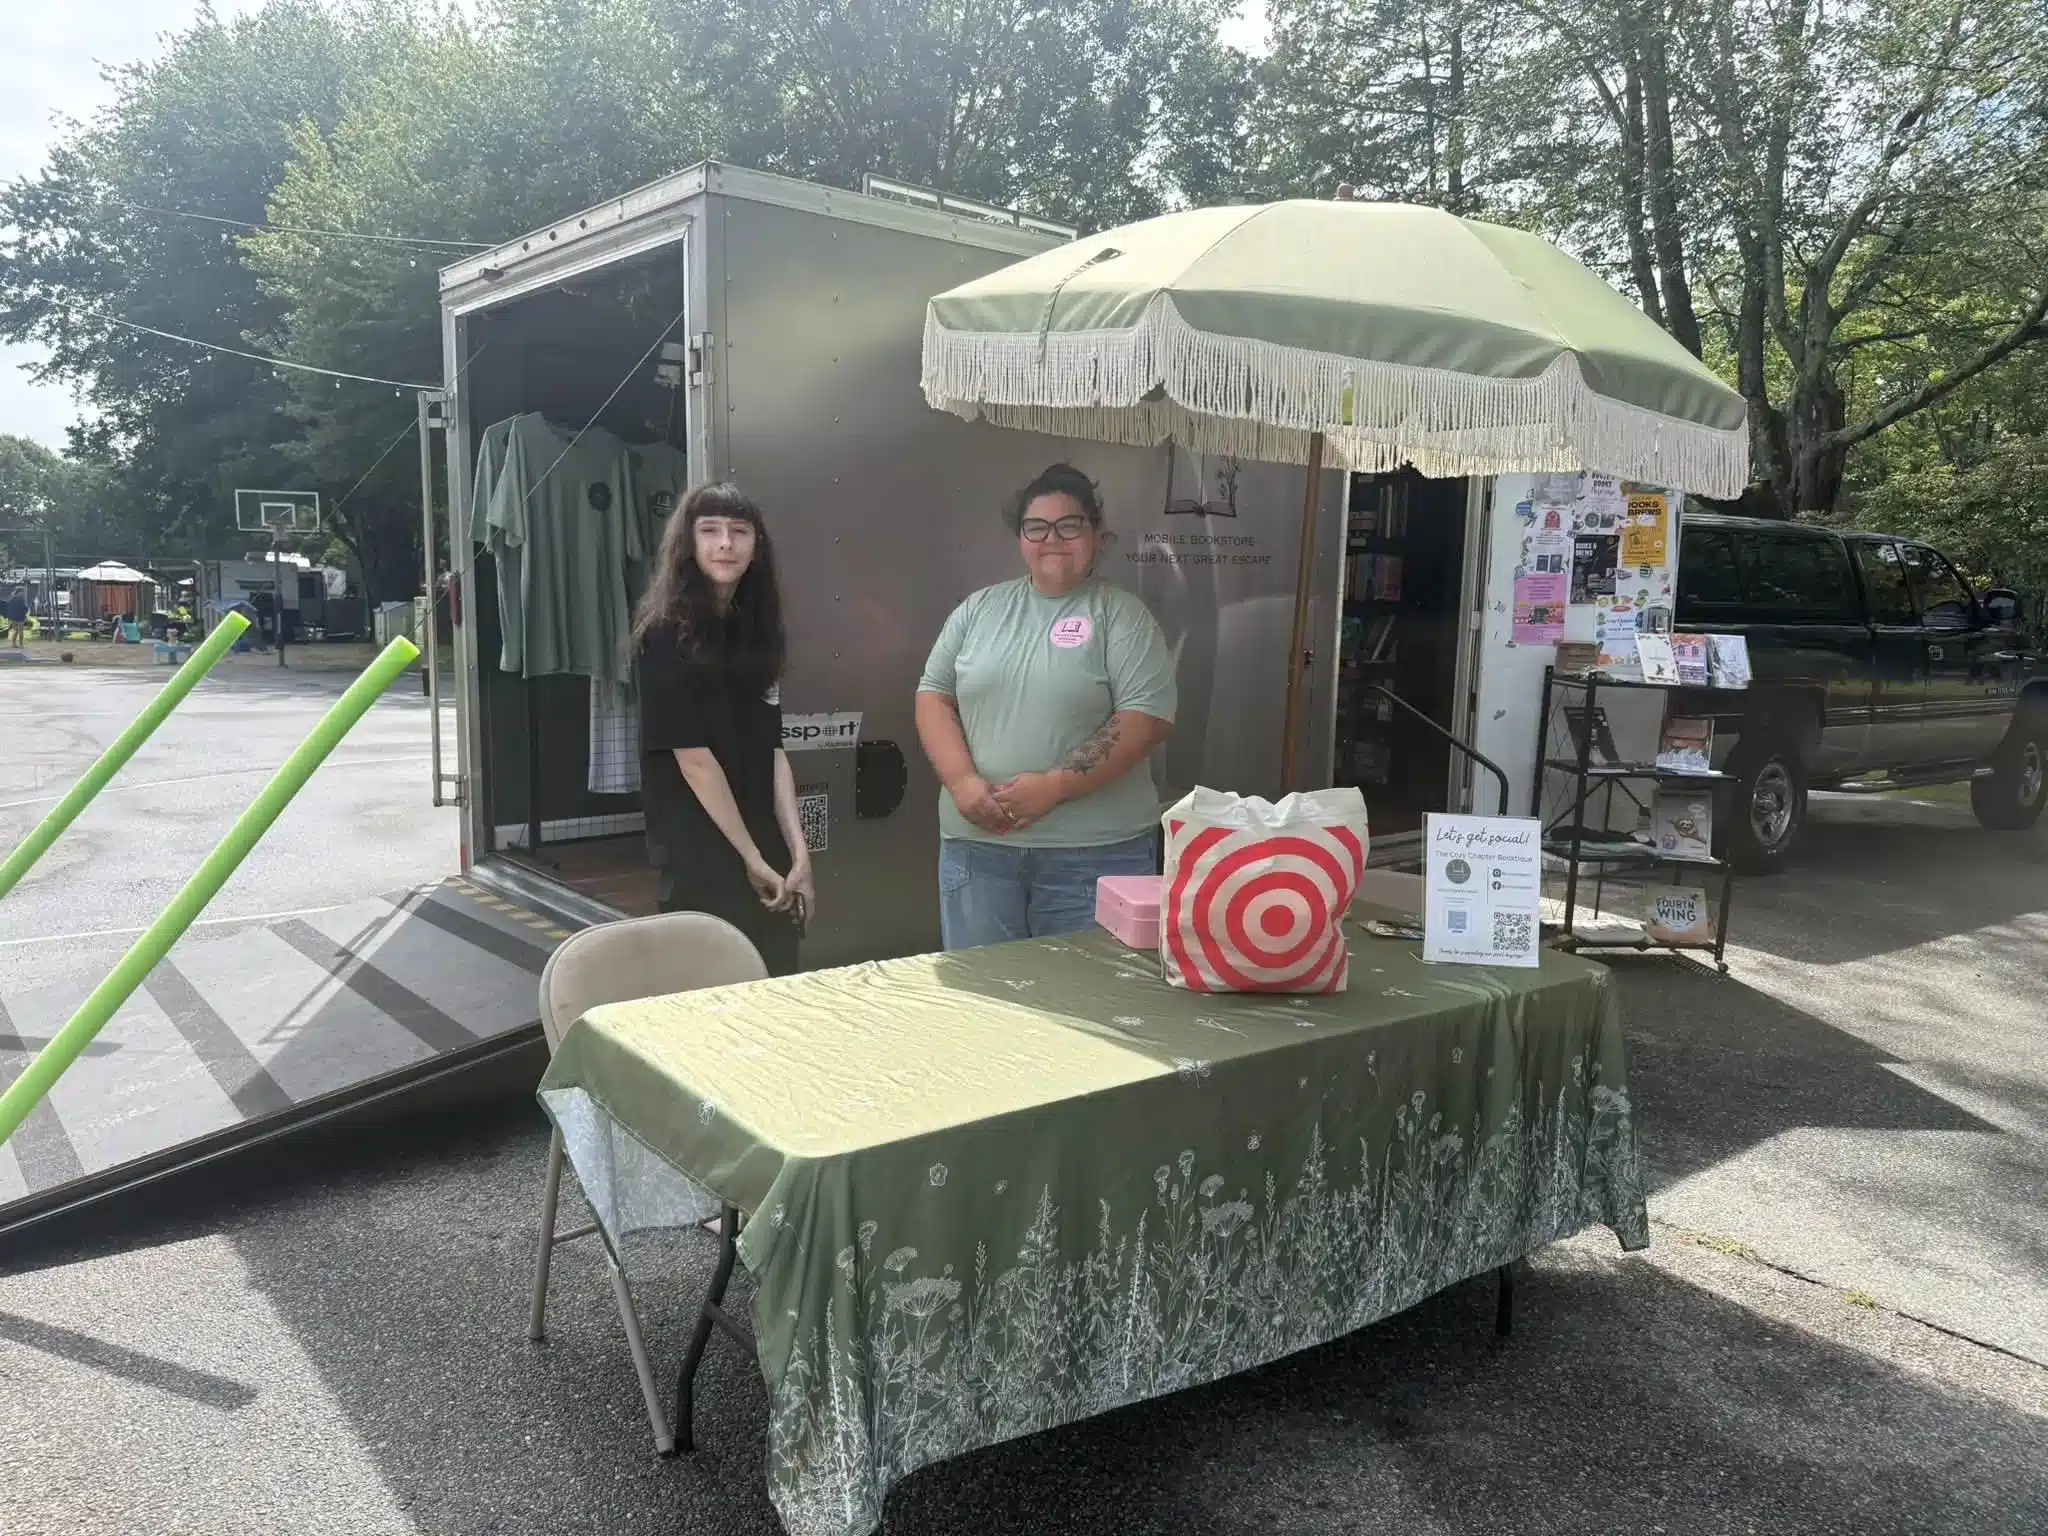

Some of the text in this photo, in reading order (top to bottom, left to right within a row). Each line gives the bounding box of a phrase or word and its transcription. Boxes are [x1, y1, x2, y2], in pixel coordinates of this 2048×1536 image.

[1144, 533, 1257, 546] MOBILE BOOKSTORE
[1126, 553, 1273, 565] YOUR NEXT GREAT ESCAPE
[1436, 826, 1530, 848] Let's get social!
[1468, 852, 1496, 861] Chapter
[1656, 899, 1695, 910] FOURTH
[1657, 908, 1696, 922] WING
